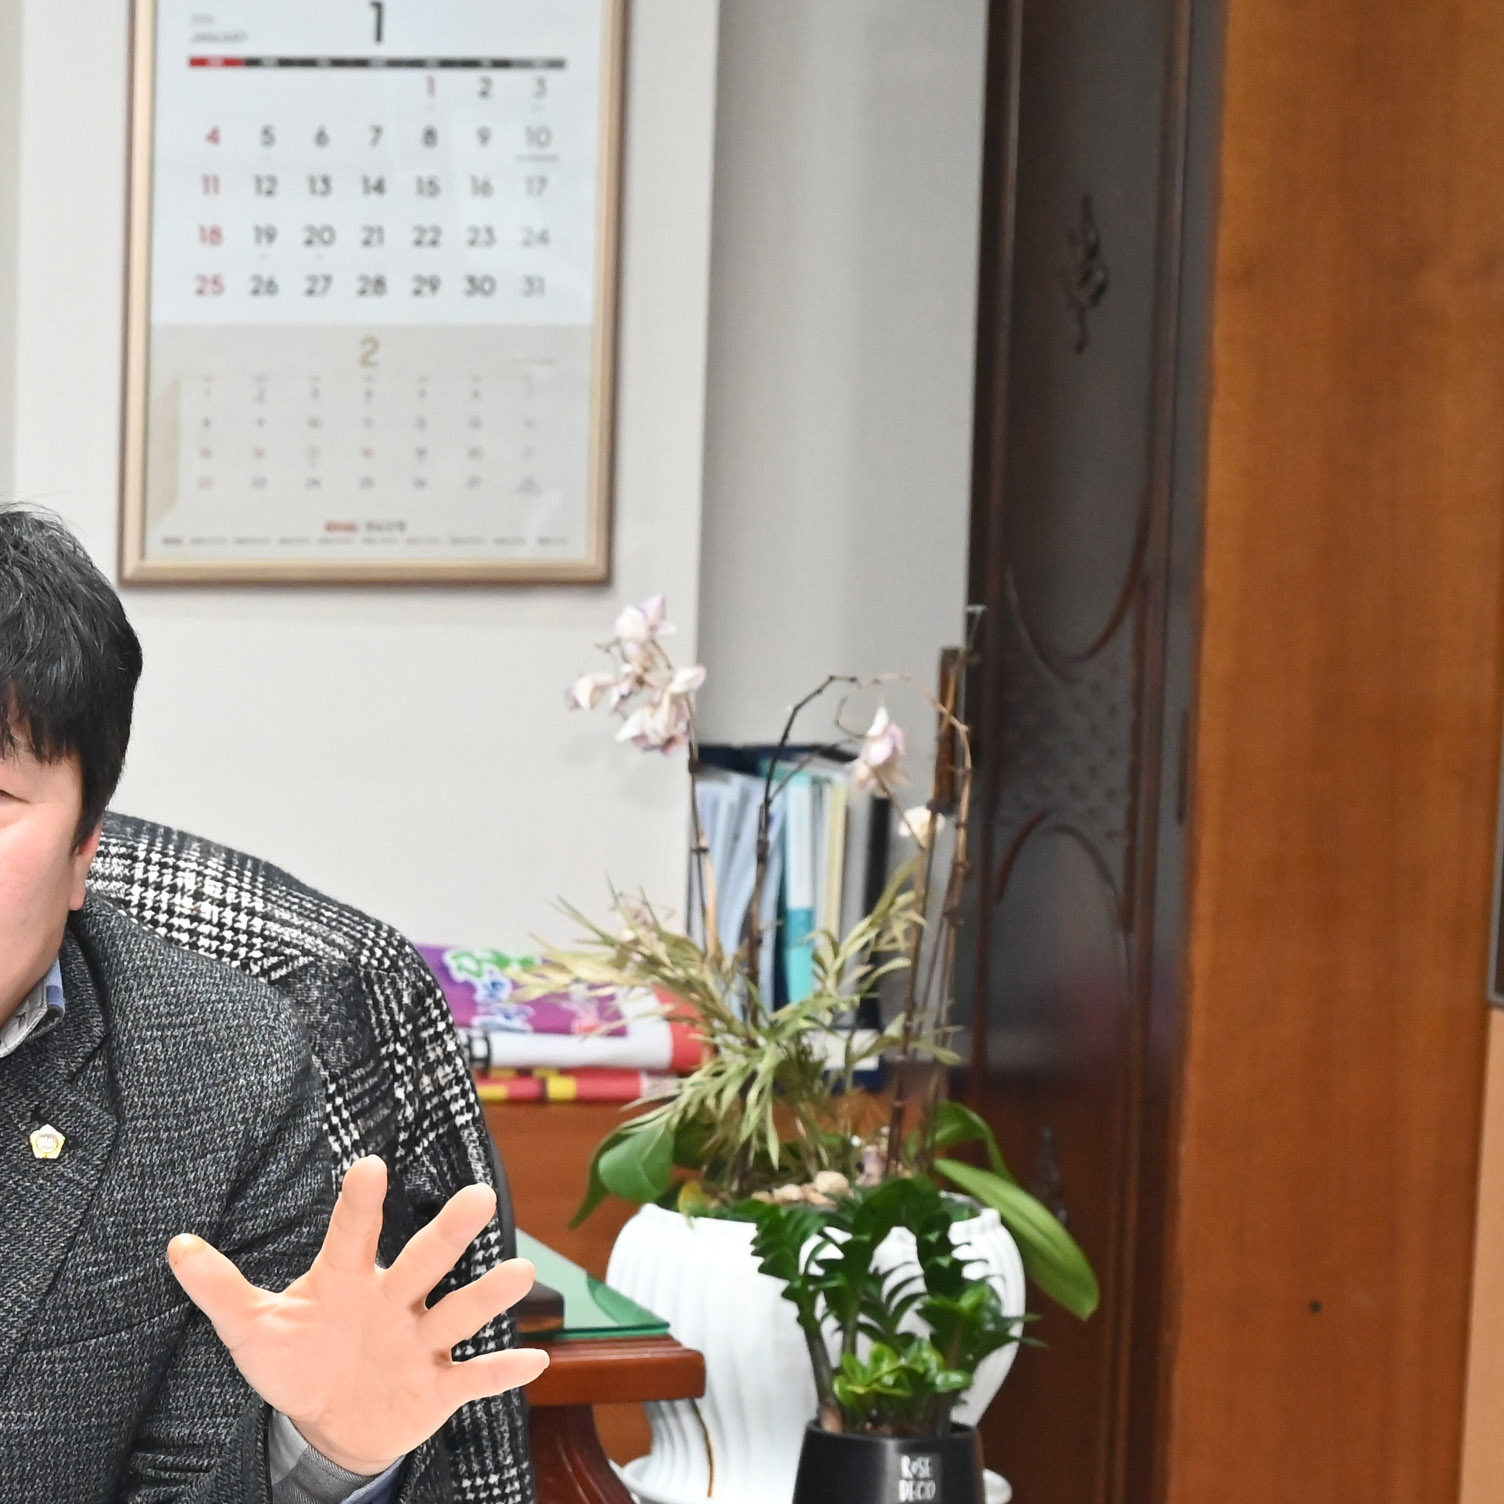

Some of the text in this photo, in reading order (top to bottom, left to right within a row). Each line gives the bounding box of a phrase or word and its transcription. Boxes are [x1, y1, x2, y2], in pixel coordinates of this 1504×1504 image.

[370, 1, 384, 43] 1
[479, 77, 492, 98] 2
[533, 77, 546, 98] 3
[206, 126, 551, 147] 4 5 6 7 8 9 10
[202, 176, 547, 196] 11 12 13 14 15 16 17
[199, 225, 549, 246] 18 19 20 21 22 23 24
[195, 275, 545, 297] 25 26 27 28 29 30 31
[359, 336, 380, 367] 2
[898, 1479, 936, 1502] DECO
